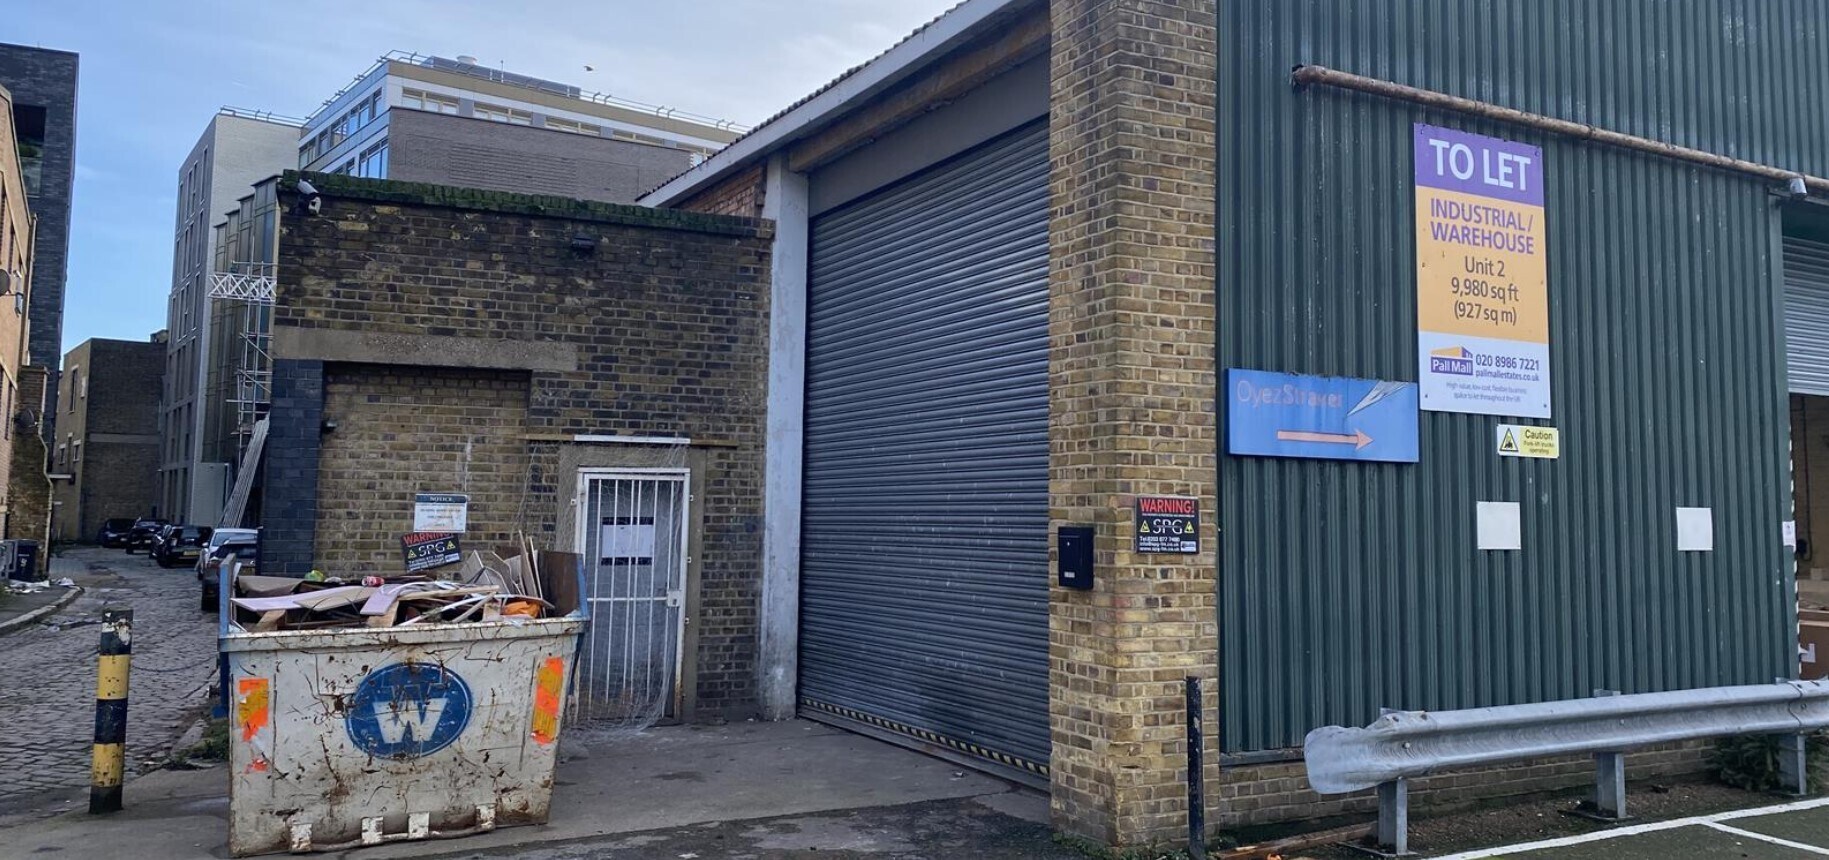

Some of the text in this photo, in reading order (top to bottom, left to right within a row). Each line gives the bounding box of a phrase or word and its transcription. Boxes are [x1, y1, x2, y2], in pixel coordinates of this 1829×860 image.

[1429, 138, 1531, 191] TO LET
[1430, 221, 1534, 254] WAREHOUSE
[1465, 255, 1505, 277] Unit 2
[1451, 276, 1520, 305] 9,980 sq ft
[1454, 300, 1517, 326] (927 sq m)
[1432, 359, 1472, 375] Pall Mall
[1475, 354, 1540, 371] 020 8986 7221
[1475, 369, 1540, 381] pallmallestates.co.uk
[1525, 429, 1553, 440] Caution
[1140, 499, 1195, 513] WARNING!
[1152, 518, 1183, 535] SPG
[418, 541, 445, 557] SPG
